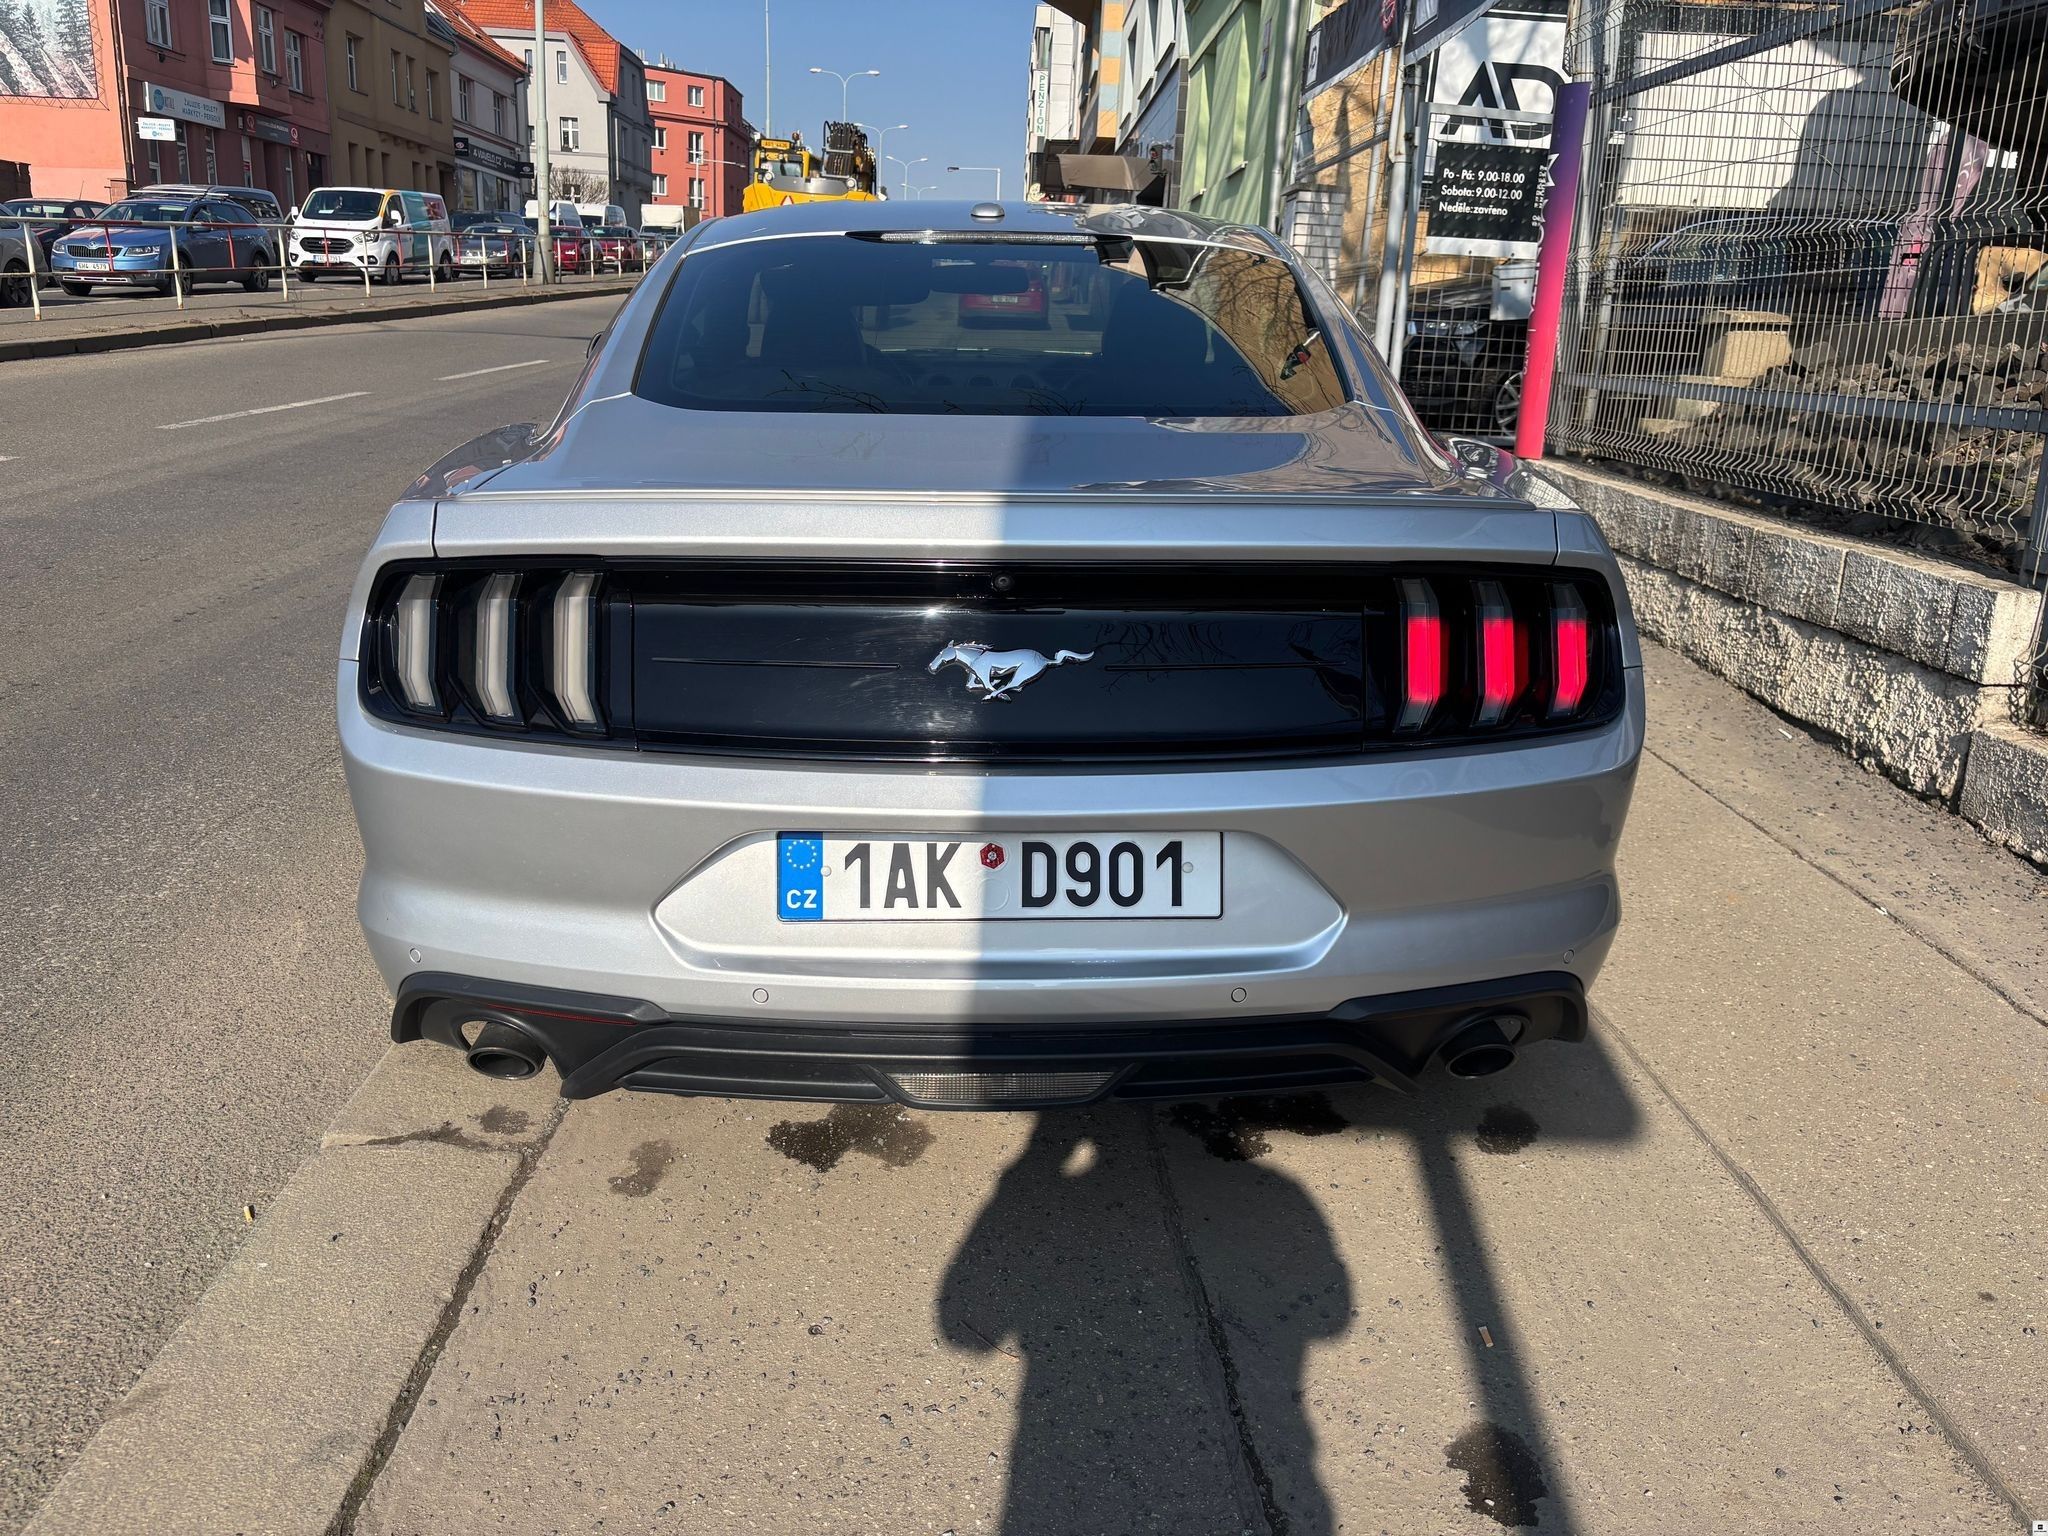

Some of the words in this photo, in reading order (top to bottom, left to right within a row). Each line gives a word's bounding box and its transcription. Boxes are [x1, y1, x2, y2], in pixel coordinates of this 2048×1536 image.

[1036, 75, 1046, 133] PENZION
[1443, 167, 1455, 179] Po
[1461, 169, 1475, 180] Pá:
[1478, 170, 1526, 184] 9.00-18.00
[1440, 184, 1475, 197] Sobota:
[1475, 186, 1523, 200] 9.00-12.00
[844, 842, 962, 909] 1AK
[1021, 841, 1183, 908] D901
[786, 889, 817, 909] CZ
